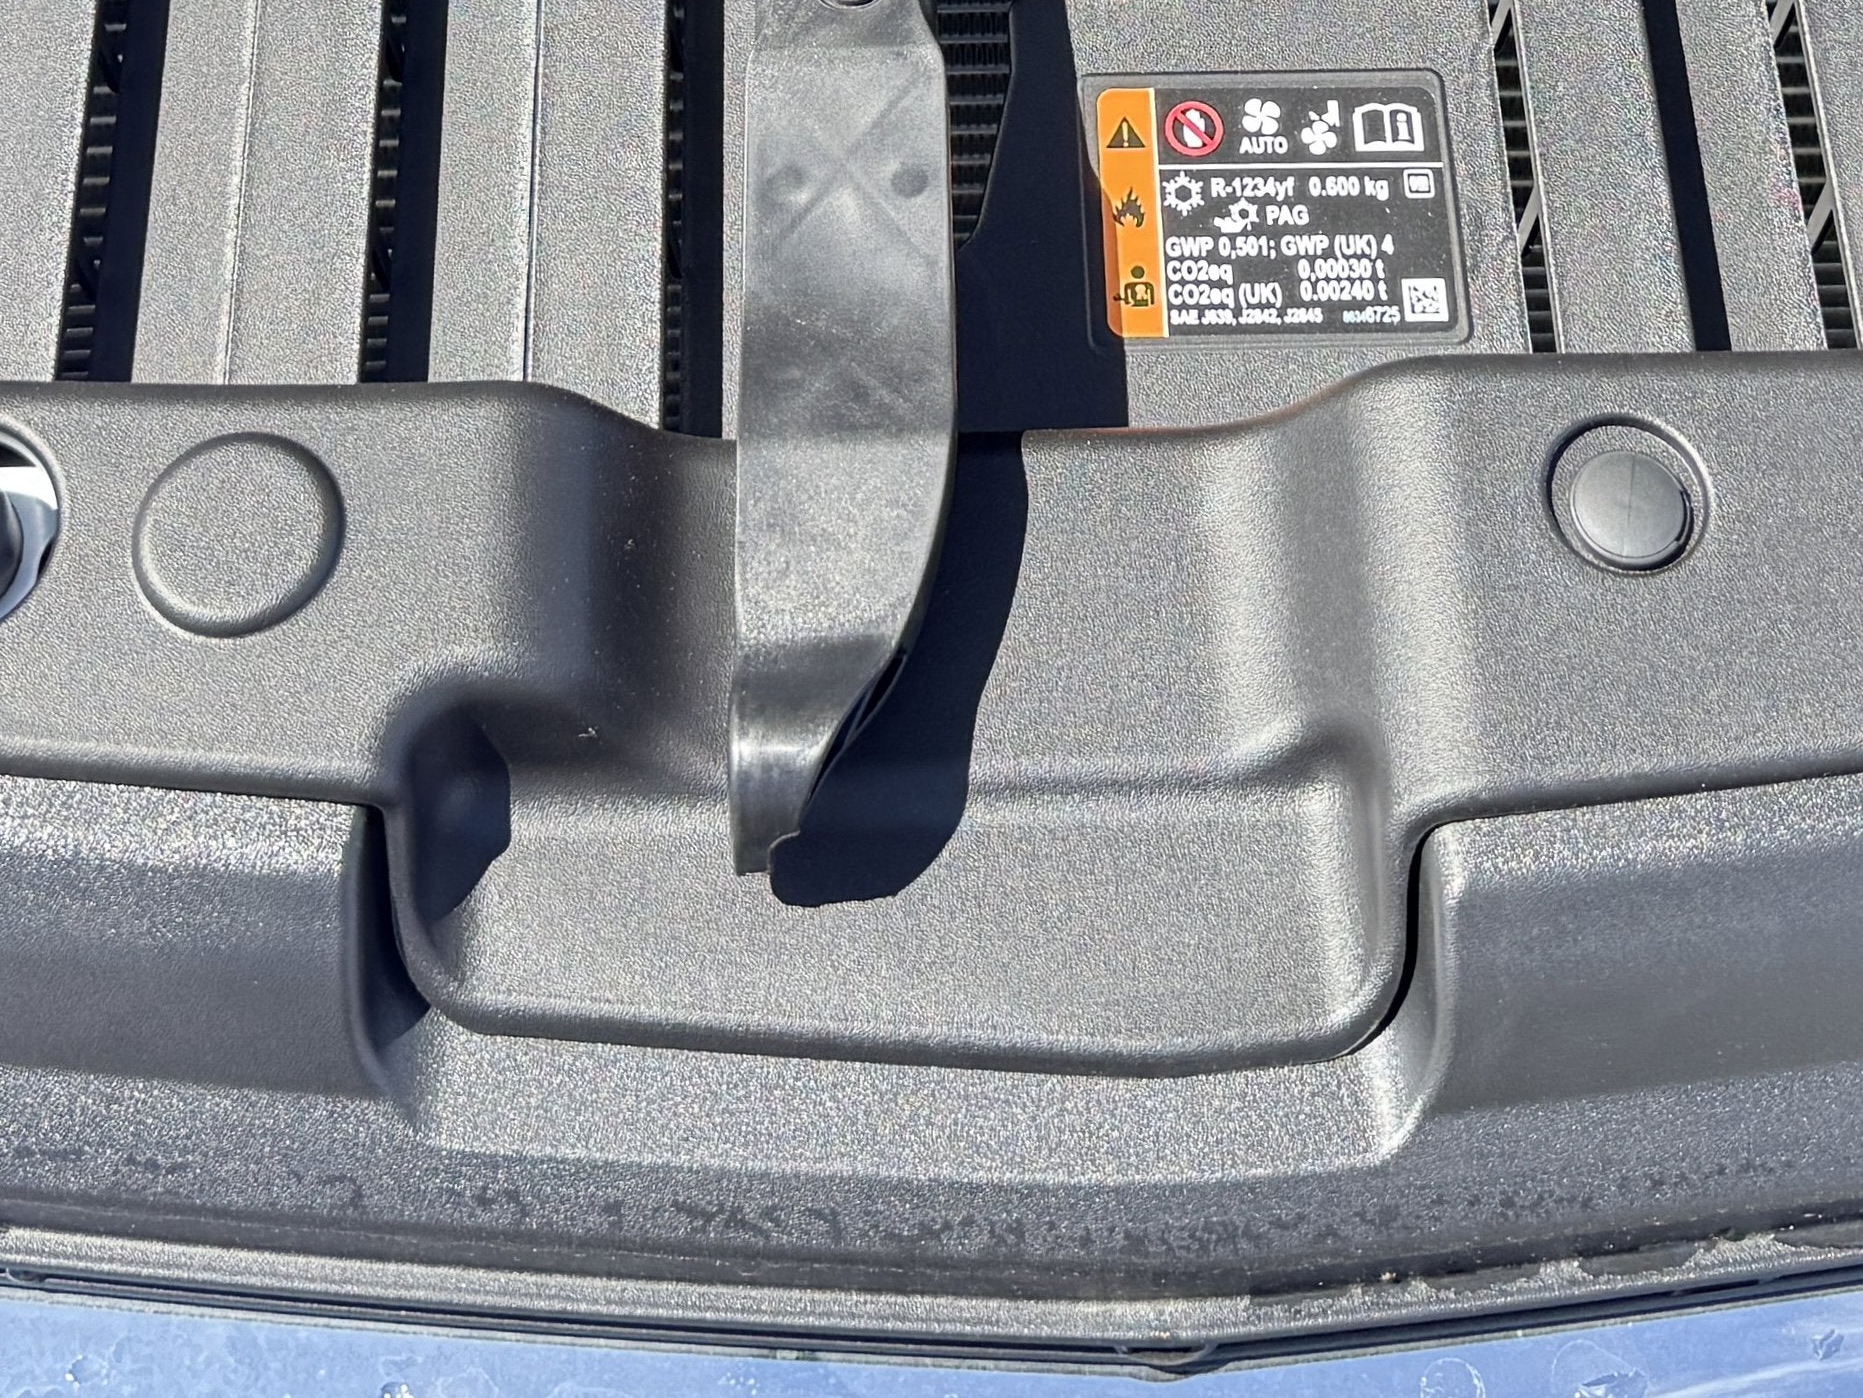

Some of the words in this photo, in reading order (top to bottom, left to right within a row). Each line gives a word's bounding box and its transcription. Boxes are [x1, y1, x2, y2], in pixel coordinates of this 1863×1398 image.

[1239, 135, 1288, 154] AUTO
[1210, 176, 1295, 201] R-1234yf
[1364, 175, 1389, 201] kg
[1266, 205, 1310, 225] PAG
[1165, 237, 1214, 257] GWP
[1218, 236, 1276, 259] 0,501;
[1280, 236, 1329, 256] GWP
[1334, 234, 1378, 260] (UK)
[1381, 234, 1395, 254] 4
[1166, 260, 1234, 284] CO2eq
[1297, 258, 1372, 281] 0,00030
[1374, 259, 1386, 279] t
[1168, 284, 1235, 307] CO2eq
[1238, 282, 1283, 306] (UK)
[1300, 280, 1374, 301] 0.00240
[1376, 281, 1389, 301] t
[1169, 308, 1200, 325] SAE
